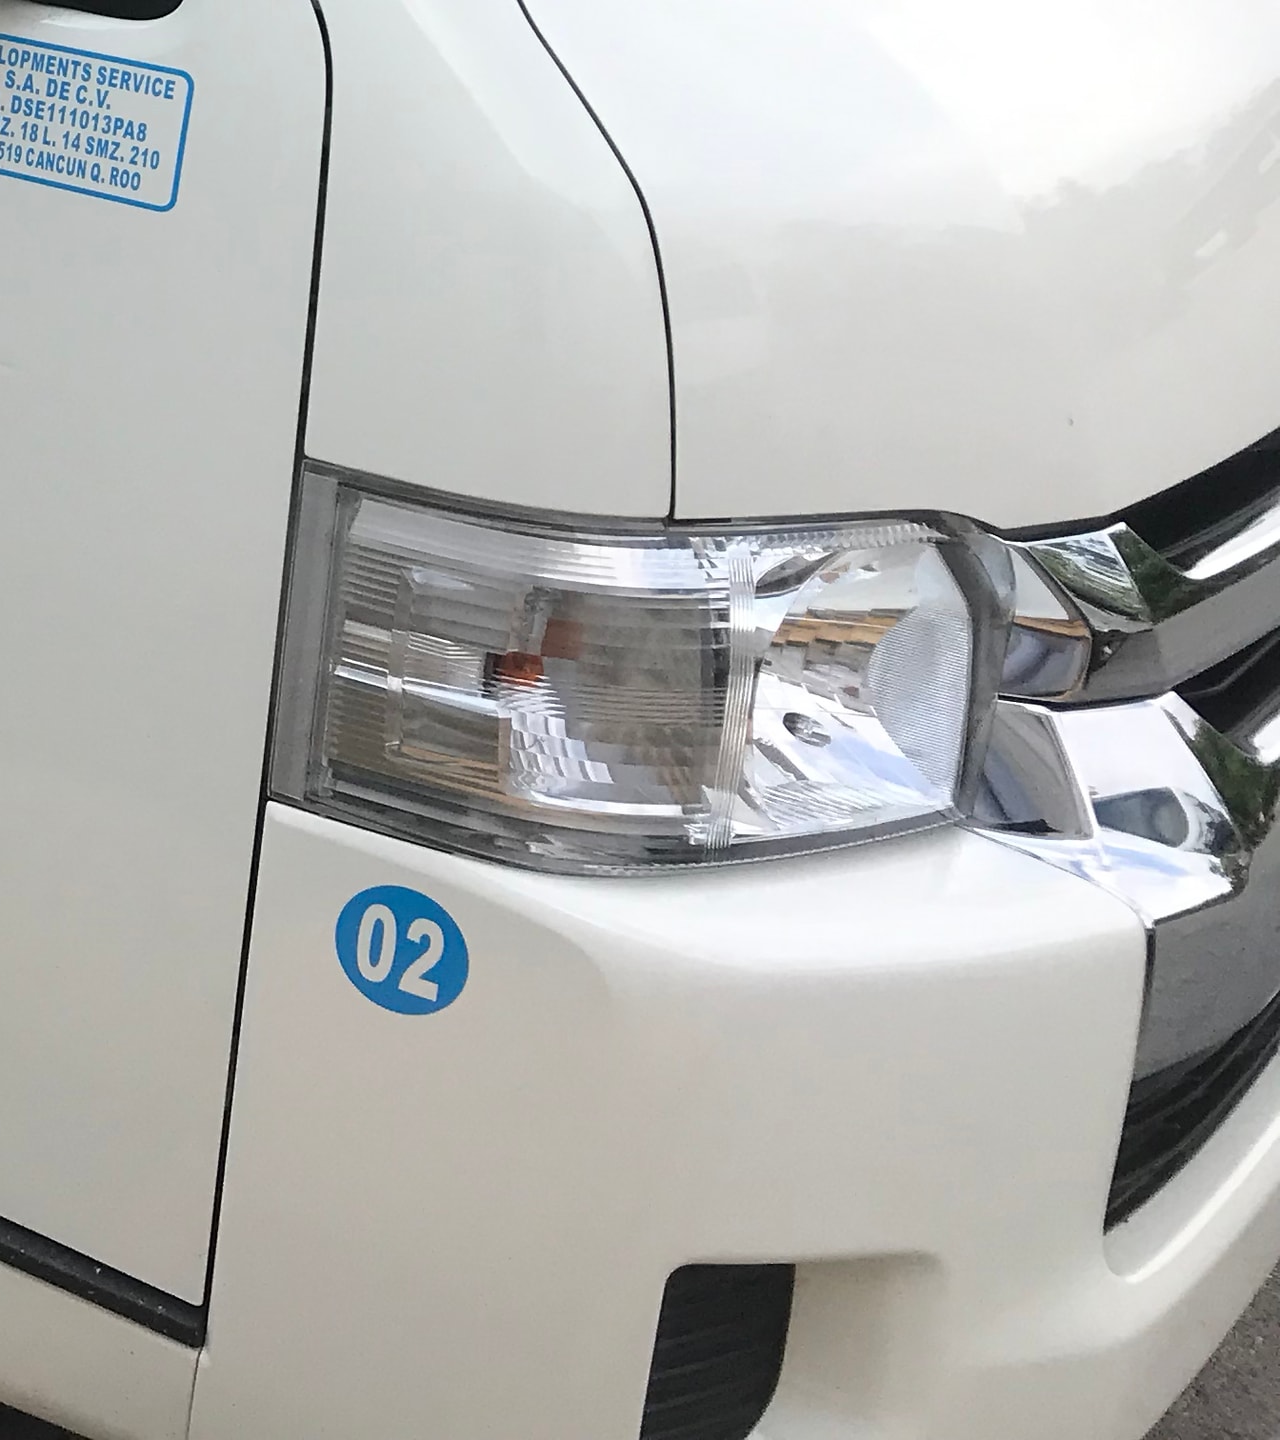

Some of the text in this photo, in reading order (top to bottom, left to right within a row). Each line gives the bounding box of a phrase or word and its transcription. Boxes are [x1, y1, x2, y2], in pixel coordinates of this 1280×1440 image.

[4, 69, 111, 110] S.A. DE C.V.
[96, 65, 176, 100] SERVICE
[10, 95, 148, 142] DSE111013PA8
[20, 122, 39, 143] 18
[42, 126, 56, 147] L.
[62, 130, 81, 152] 14
[84, 135, 124, 163] SMZ.
[129, 146, 160, 170] 210
[25, 147, 88, 179] CANCUN
[90, 164, 105, 184] Q.
[109, 167, 141, 191] ROO
[357, 903, 444, 1002] 02
